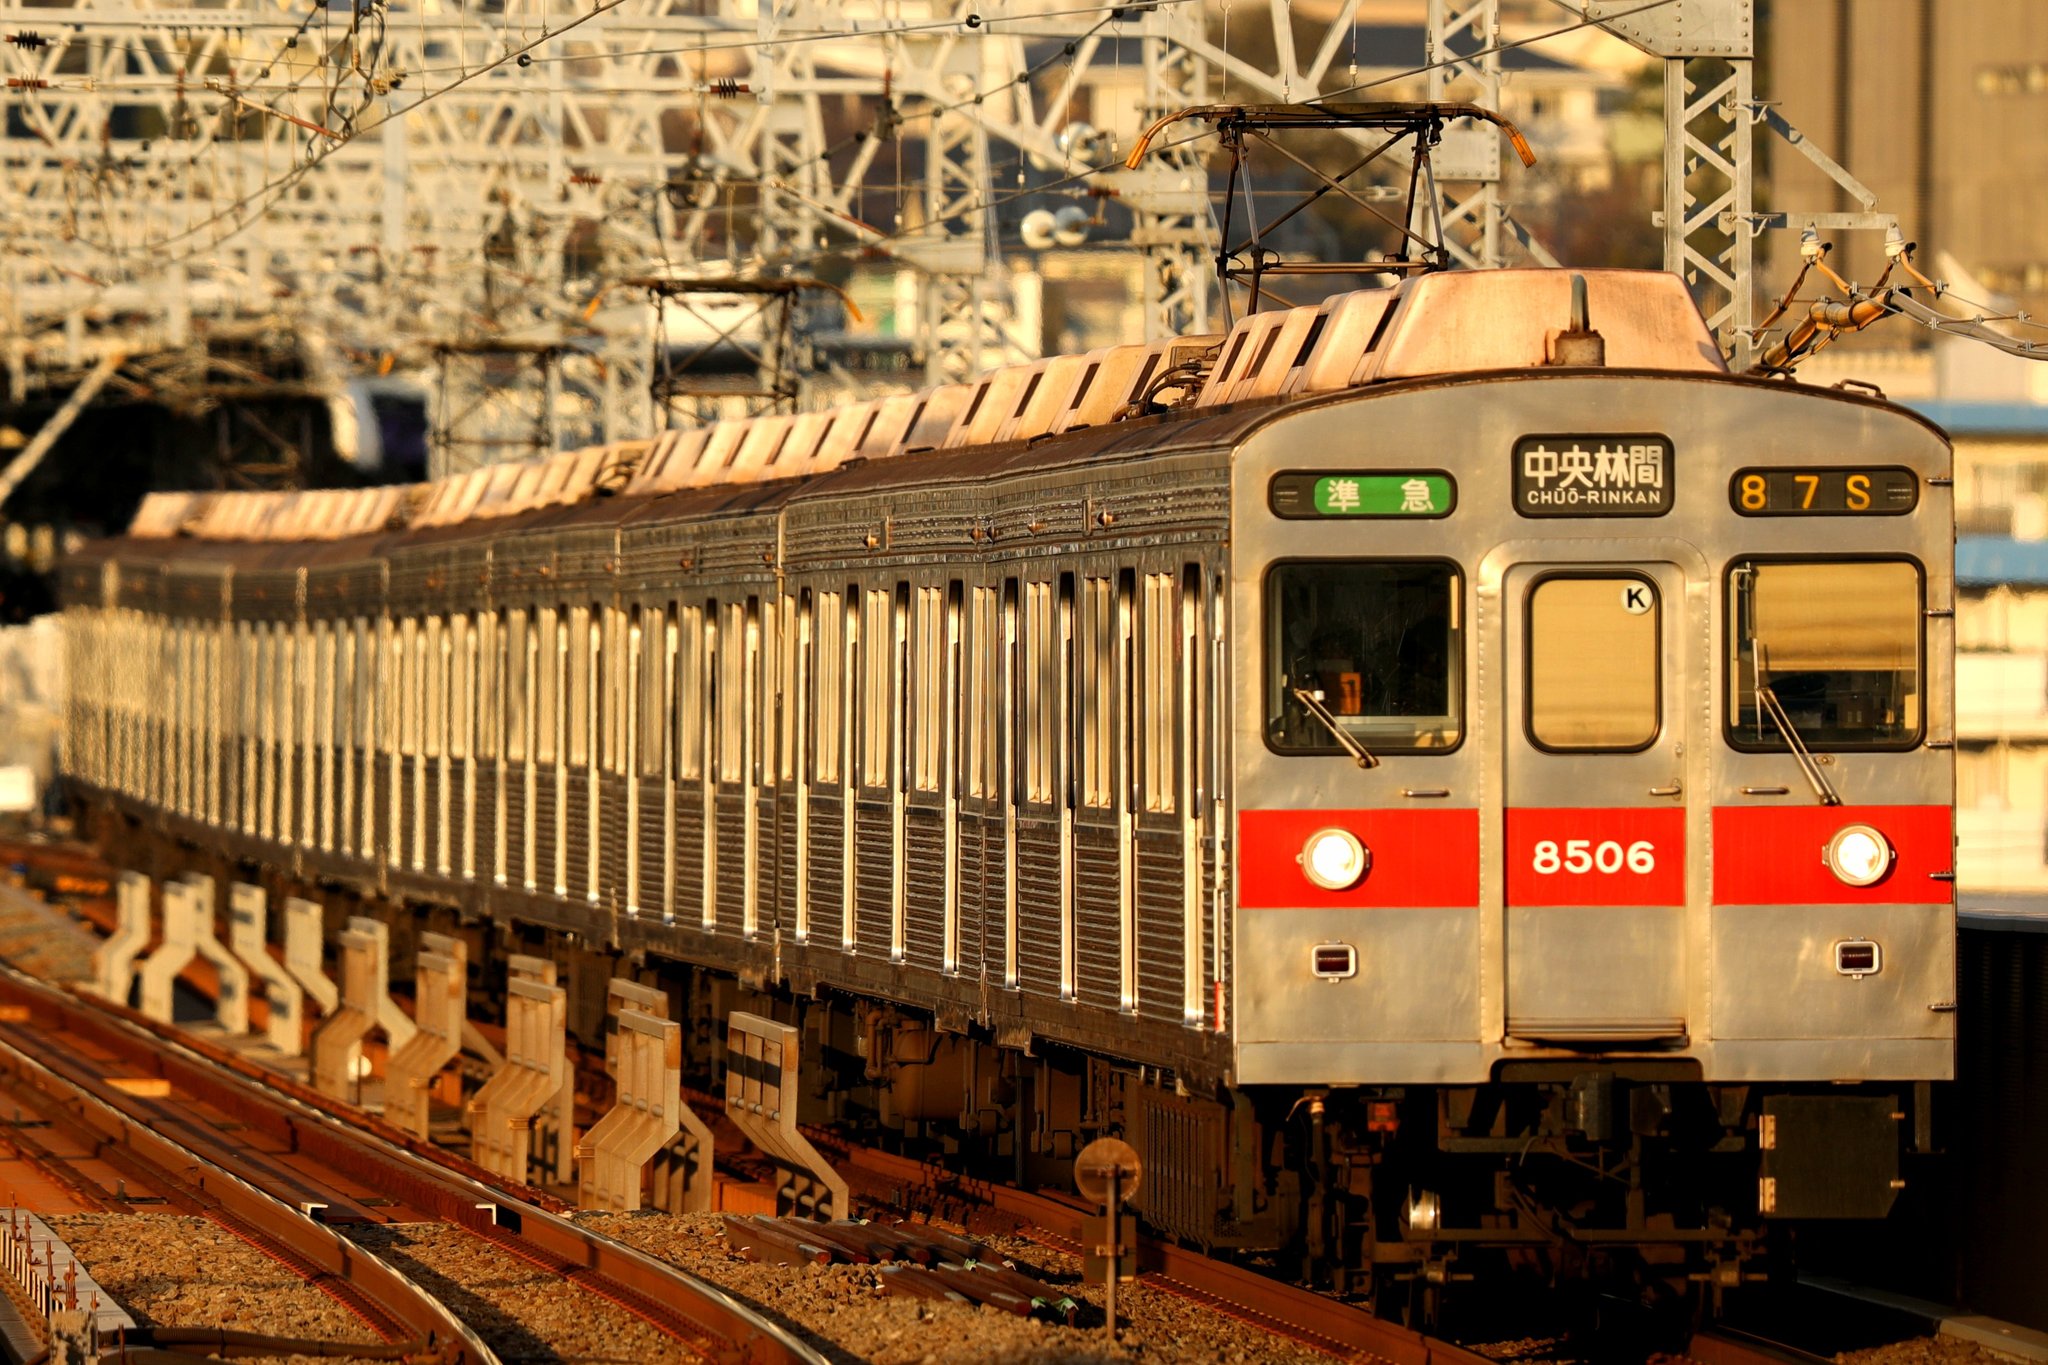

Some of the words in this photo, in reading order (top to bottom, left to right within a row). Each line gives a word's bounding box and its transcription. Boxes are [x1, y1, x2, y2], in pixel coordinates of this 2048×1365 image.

[1524, 444, 1664, 488] 中央林間
[1526, 488, 1661, 505] CHŪŌ-RINKAN
[1741, 474, 1766, 510] 8
[1794, 475, 1820, 510] 7
[1846, 474, 1871, 511] S
[1627, 587, 1647, 609] K
[1532, 839, 1656, 875] 8506
